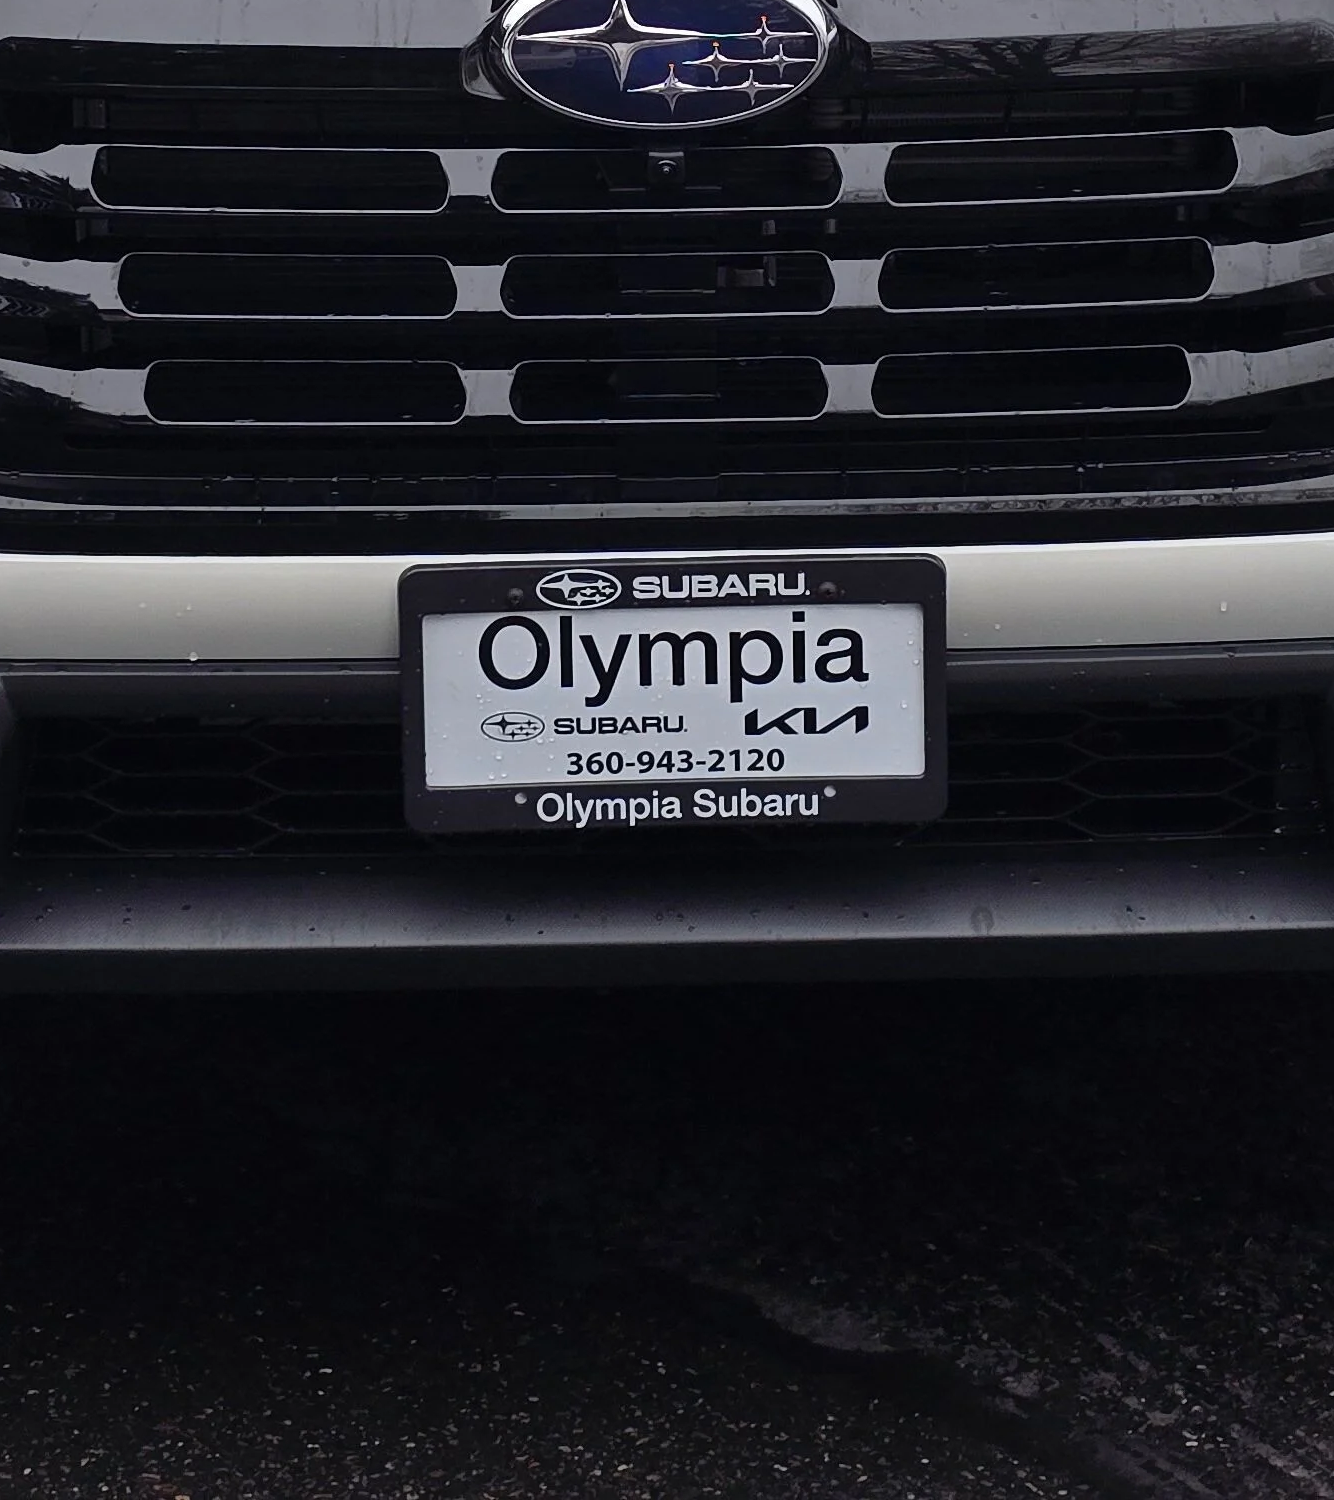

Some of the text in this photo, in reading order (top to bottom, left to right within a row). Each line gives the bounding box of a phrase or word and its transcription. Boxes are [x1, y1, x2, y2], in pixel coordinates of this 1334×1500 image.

[478, 612, 869, 707] Olympia
[566, 748, 785, 776] 360-943-2120
[536, 789, 819, 828] Olympia Subaru
